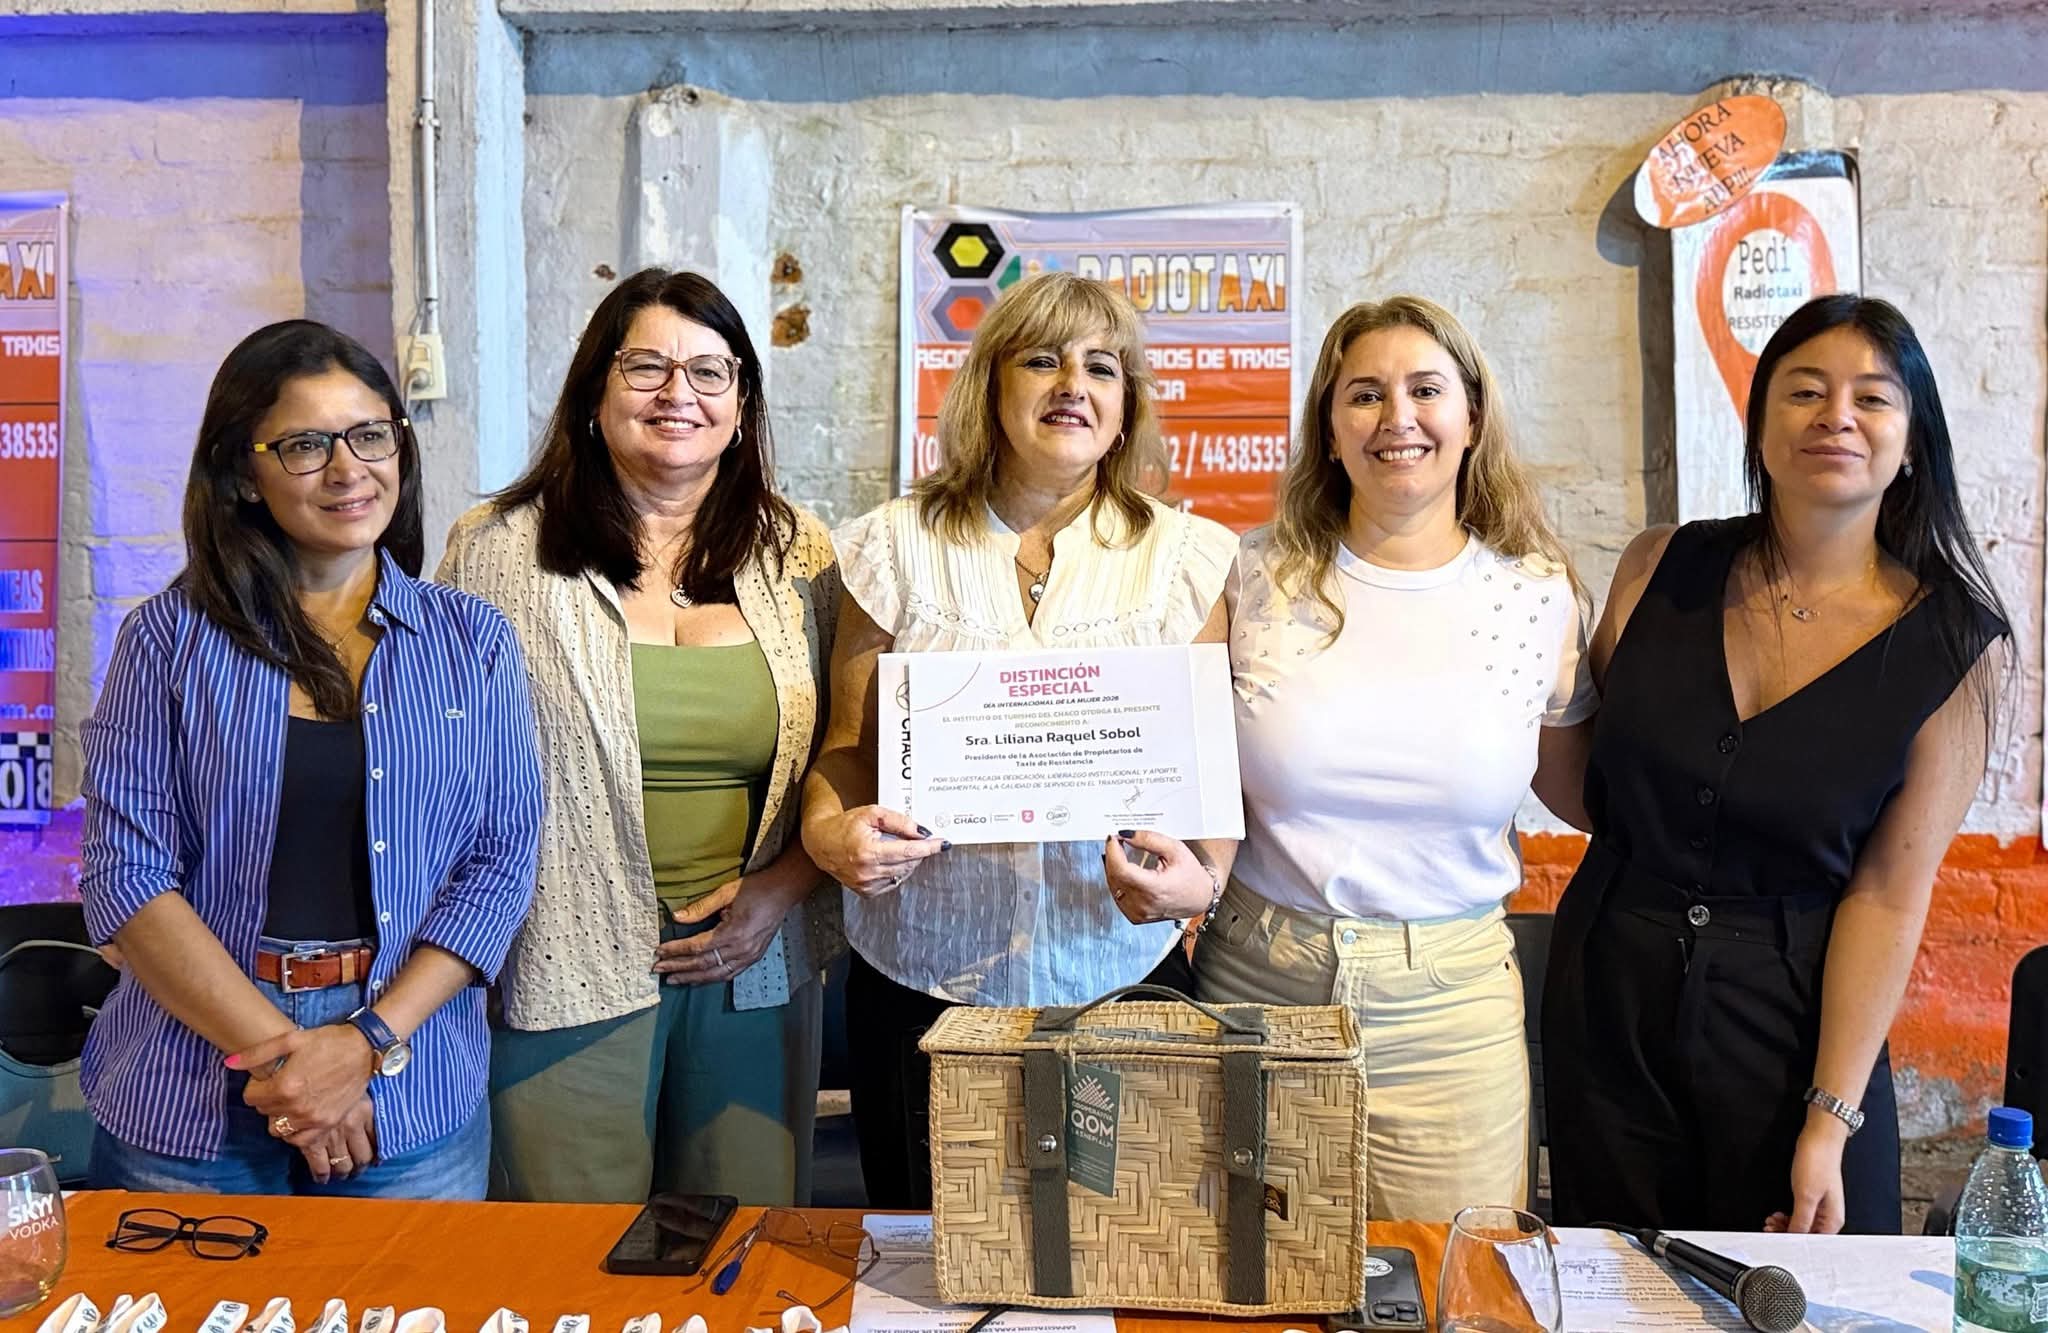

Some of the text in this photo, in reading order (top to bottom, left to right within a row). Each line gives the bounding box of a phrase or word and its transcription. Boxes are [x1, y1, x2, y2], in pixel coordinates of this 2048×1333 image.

[1659, 103, 1731, 160] AHORA
[1673, 131, 1745, 193] NUEVA
[1739, 236, 1791, 275] Pedí
[1733, 285, 1803, 301] Radiotaxi
[1, 335, 60, 357] TAXIS
[1196, 348, 1226, 370] DE
[1228, 347, 1291, 370] TAXIS
[999, 662, 1101, 684] DISTINCIÓN
[1008, 681, 1094, 698] ESPECIAL
[997, 700, 1054, 708] INTERNACIONAL
[1053, 710, 1080, 718] CHACO
[965, 727, 1141, 746] Sra. Liliana Raquel Sobol
[965, 753, 1006, 761] Presidente
[1084, 748, 1132, 758] Propietarios
[1048, 758, 1093, 767] Resistencia
[953, 816, 987, 824] CHACO
[1070, 1109, 1114, 1141] QOM
[8, 1215, 59, 1241] VODKA
